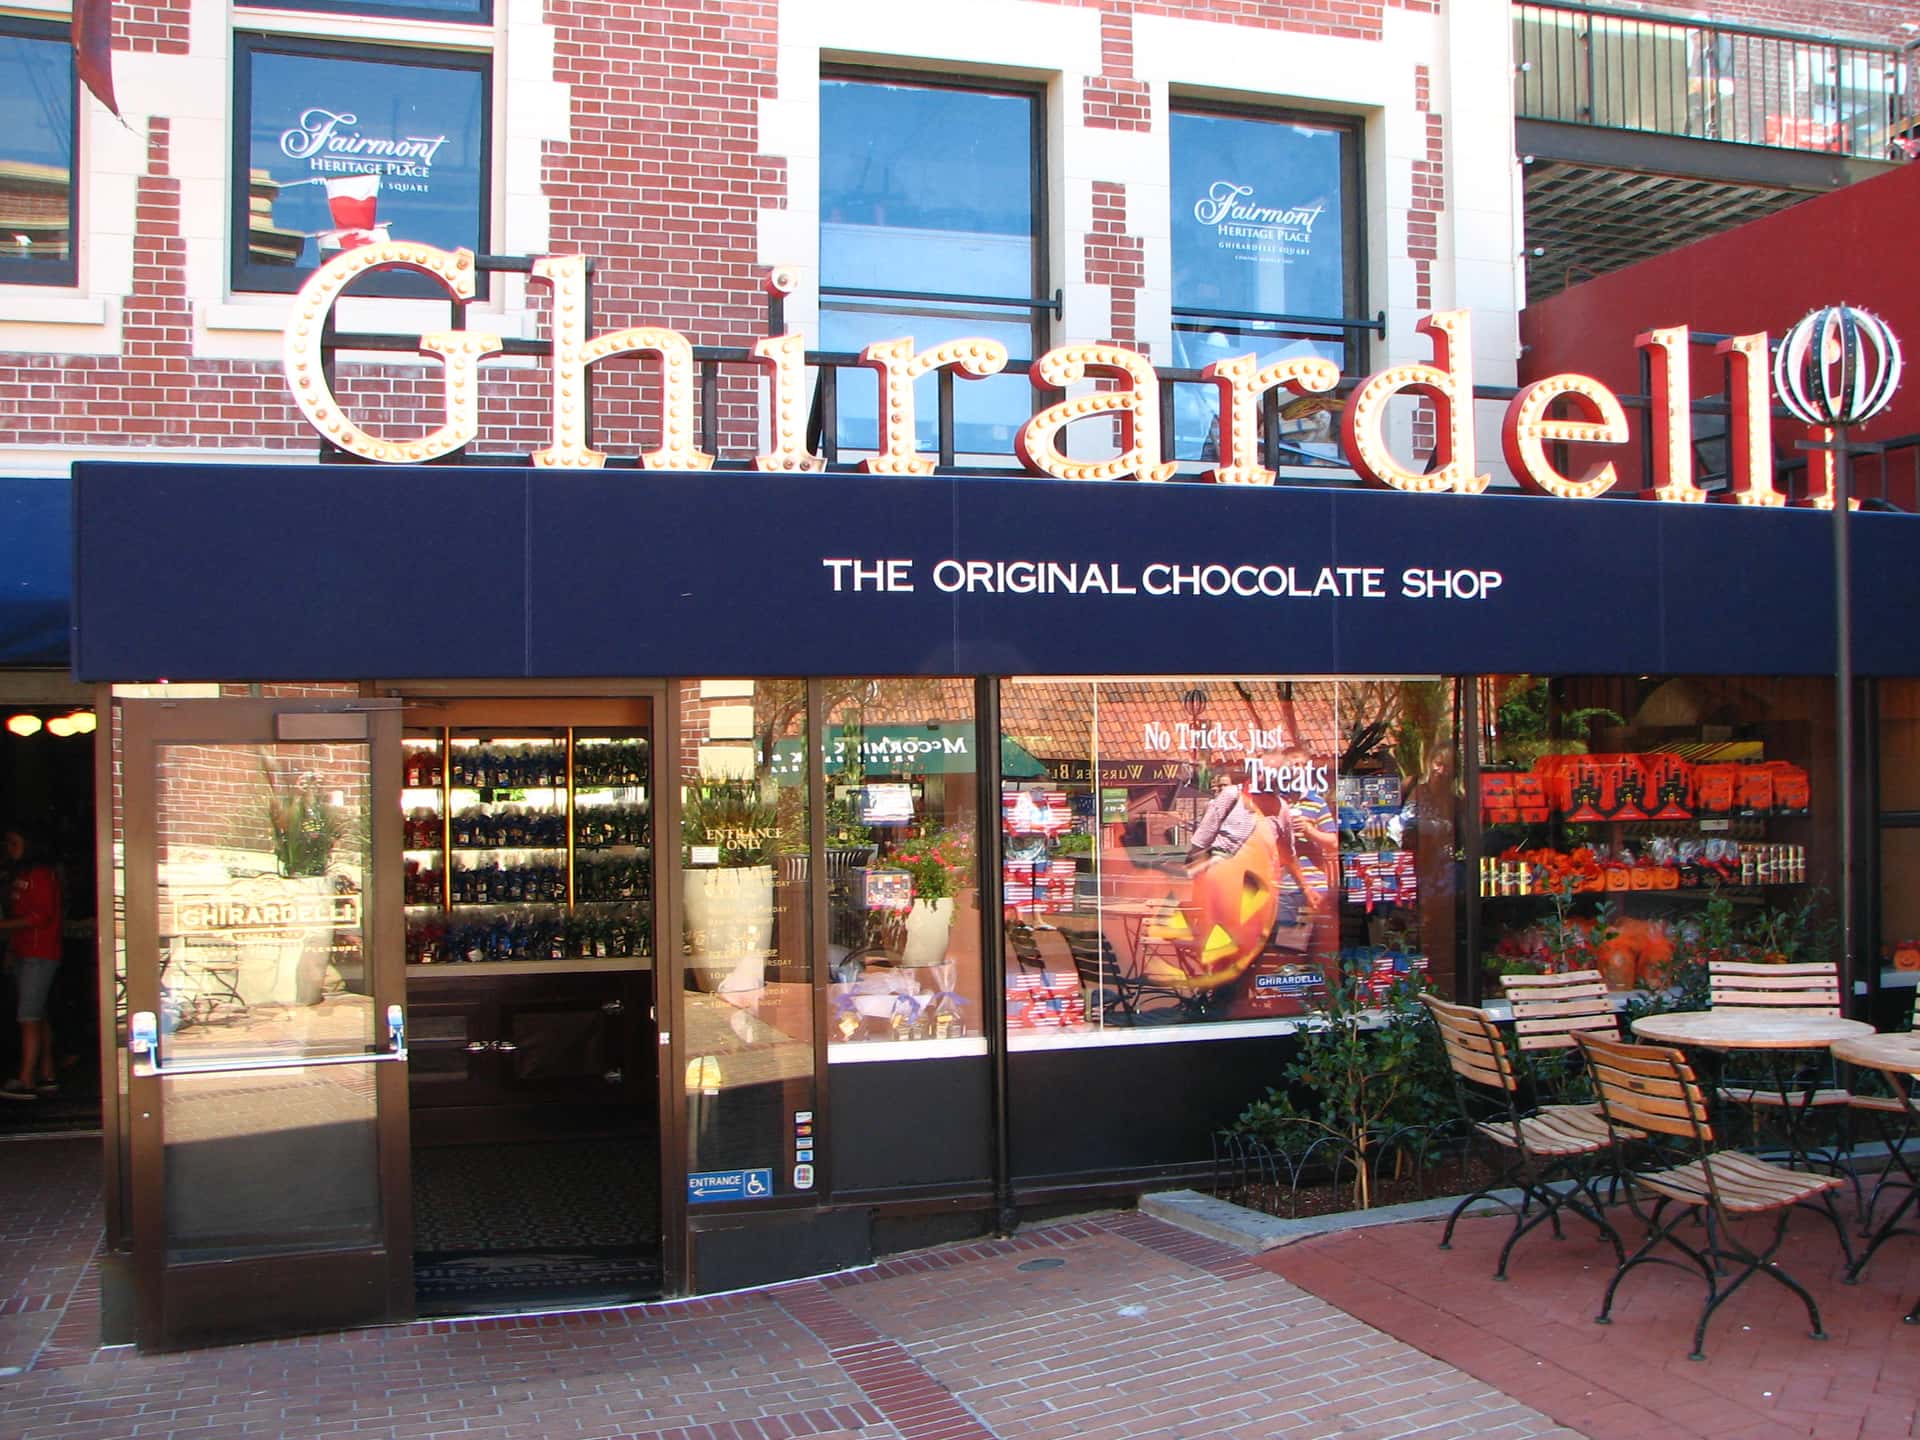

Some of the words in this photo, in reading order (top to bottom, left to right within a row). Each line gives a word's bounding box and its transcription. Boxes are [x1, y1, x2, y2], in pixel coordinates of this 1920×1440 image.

[280, 108, 450, 166] Fairmont
[310, 158, 383, 175] HERITAGE
[387, 163, 430, 178] PLACE
[388, 183, 429, 192] SQUARE
[1194, 181, 1326, 233] Fairmont
[1218, 224, 1273, 239] HERITAGE
[1277, 230, 1311, 243] PLACE
[822, 559, 915, 593] THE
[932, 560, 1138, 595] ORIGINAL
[1142, 564, 1386, 598] CHOCOLATE
[1401, 568, 1503, 600] SHOP
[1143, 721, 1171, 751] No
[1175, 722, 1244, 752] Tricks,
[1246, 722, 1287, 754] just
[1244, 757, 1329, 794] Treats
[706, 827, 784, 841] ENTRANCE
[726, 838, 763, 850] ONLY
[181, 903, 354, 926] GHIRARDELLI
[689, 1175, 742, 1188] ENTRANCE
